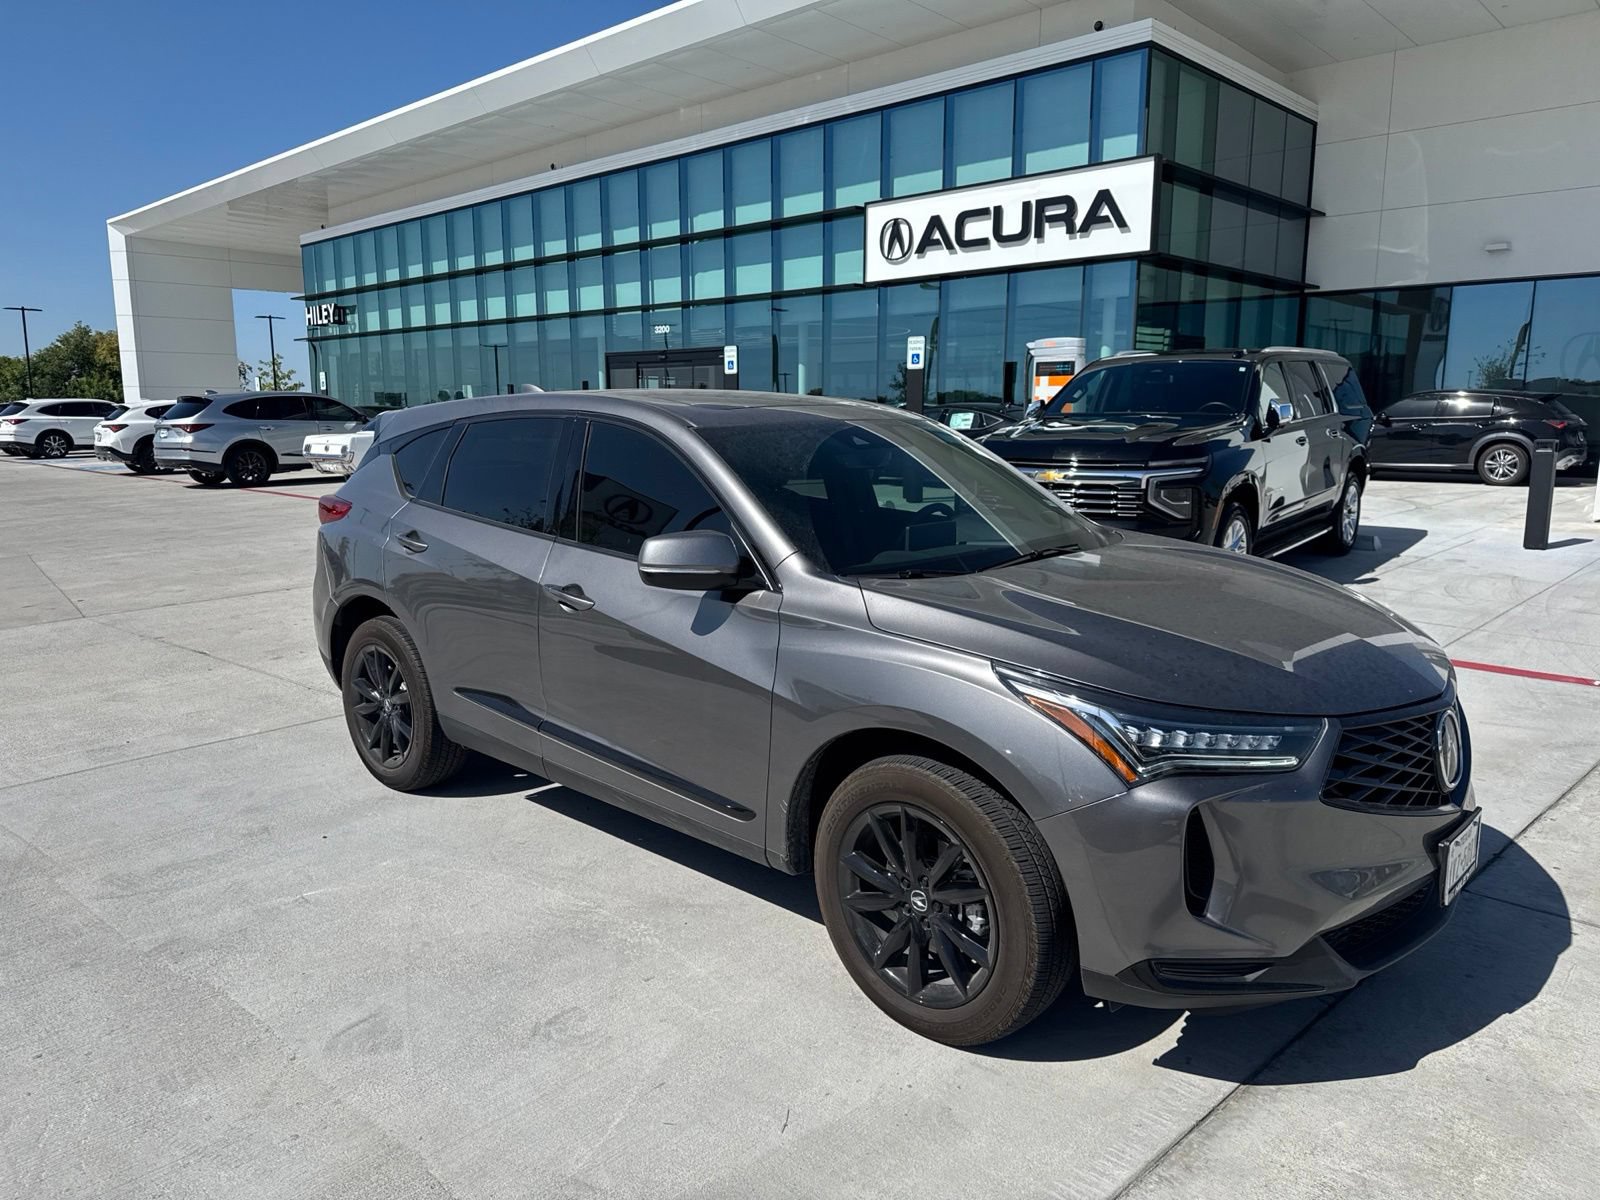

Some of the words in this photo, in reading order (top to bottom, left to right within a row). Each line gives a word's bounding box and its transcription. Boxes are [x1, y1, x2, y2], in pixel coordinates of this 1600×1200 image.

[914, 188, 1130, 255] ACURA
[305, 302, 335, 326] HILEY
[654, 325, 670, 334] 3200
